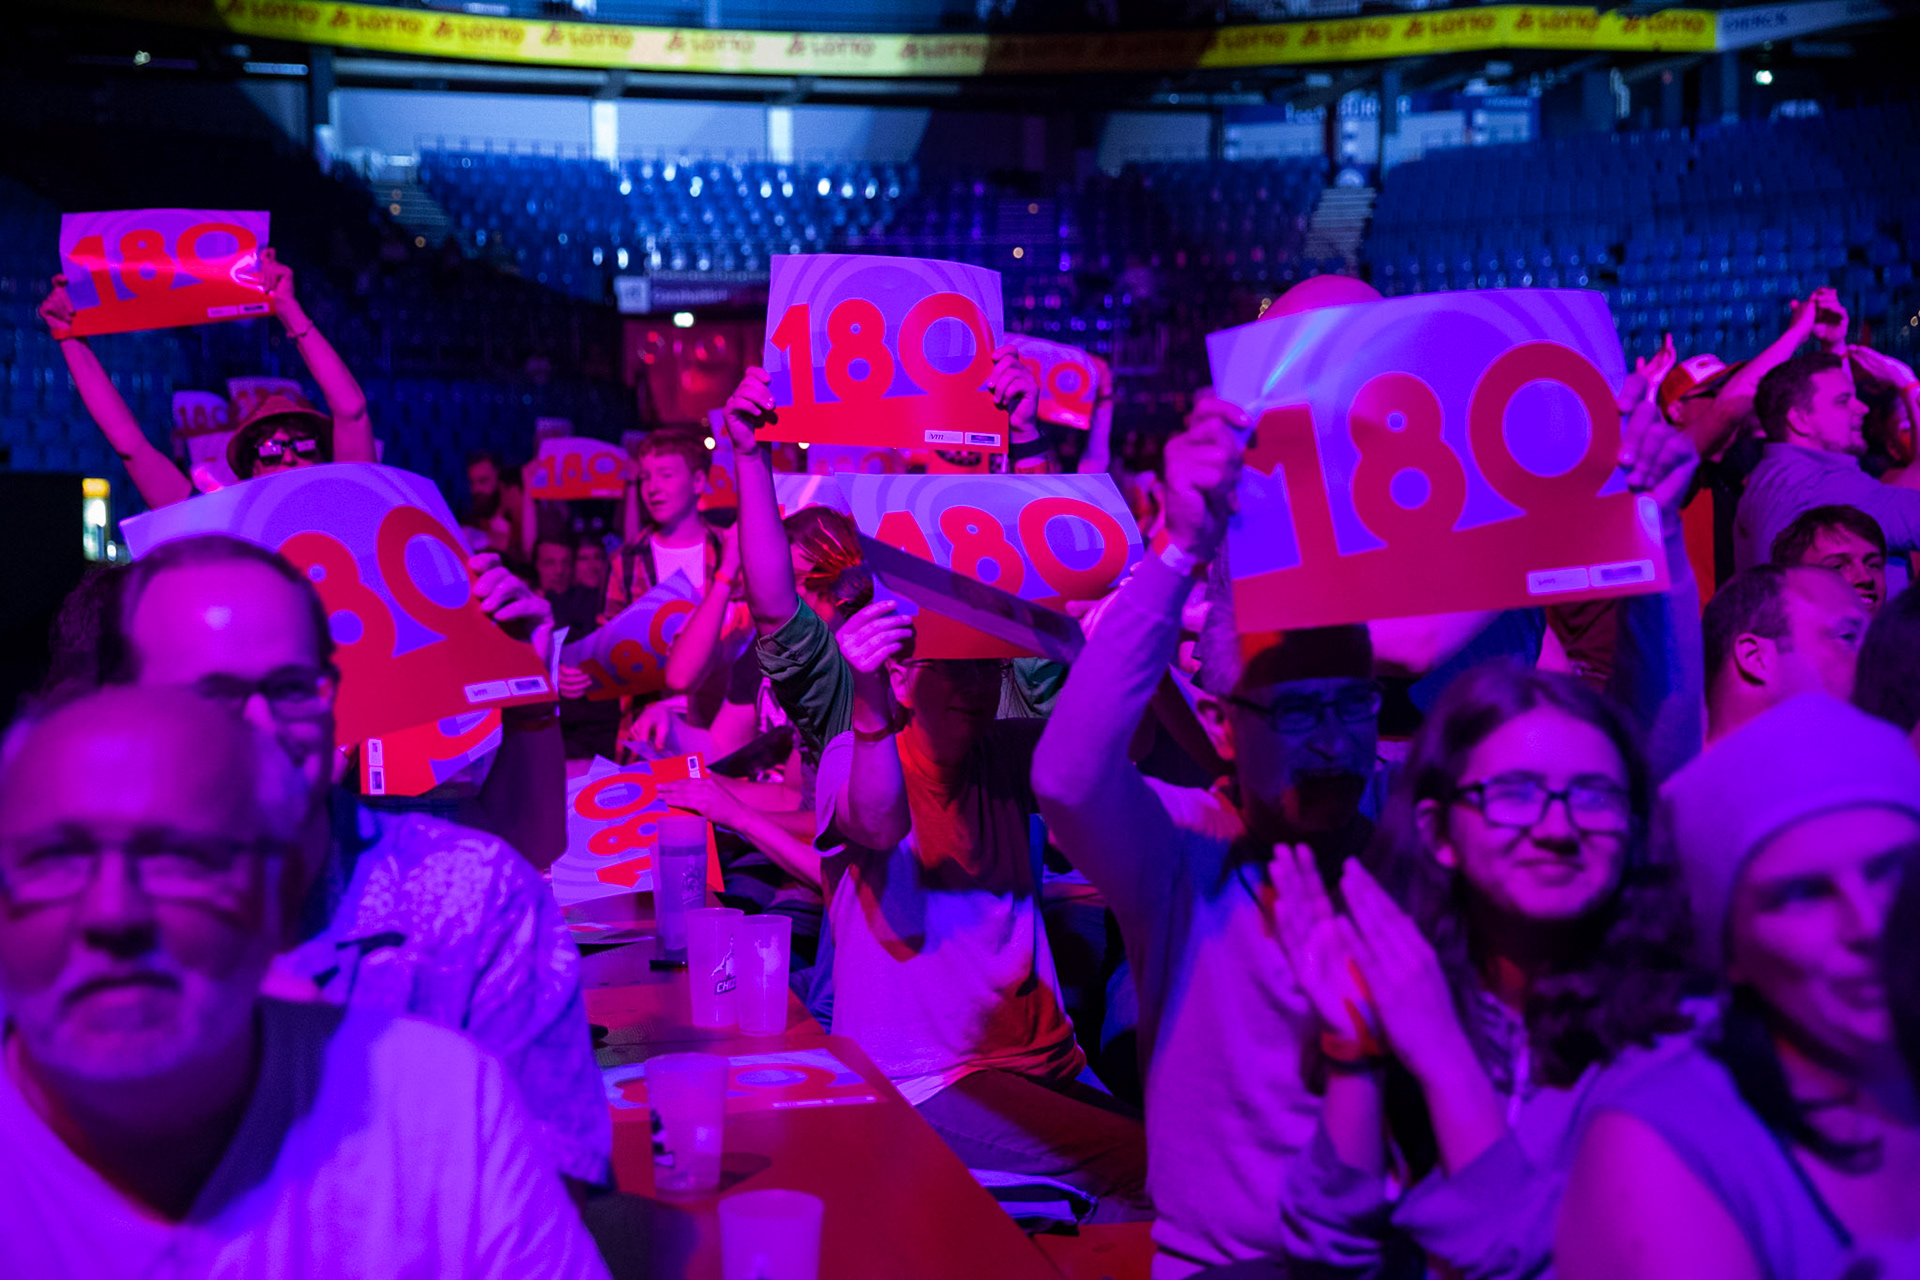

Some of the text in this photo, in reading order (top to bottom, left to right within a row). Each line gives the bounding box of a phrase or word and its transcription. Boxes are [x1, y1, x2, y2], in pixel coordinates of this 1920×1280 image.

[66, 222, 258, 305] 180
[769, 291, 997, 405] 180
[538, 453, 624, 489] 180
[1243, 340, 1622, 564] 180
[277, 504, 480, 658] 80
